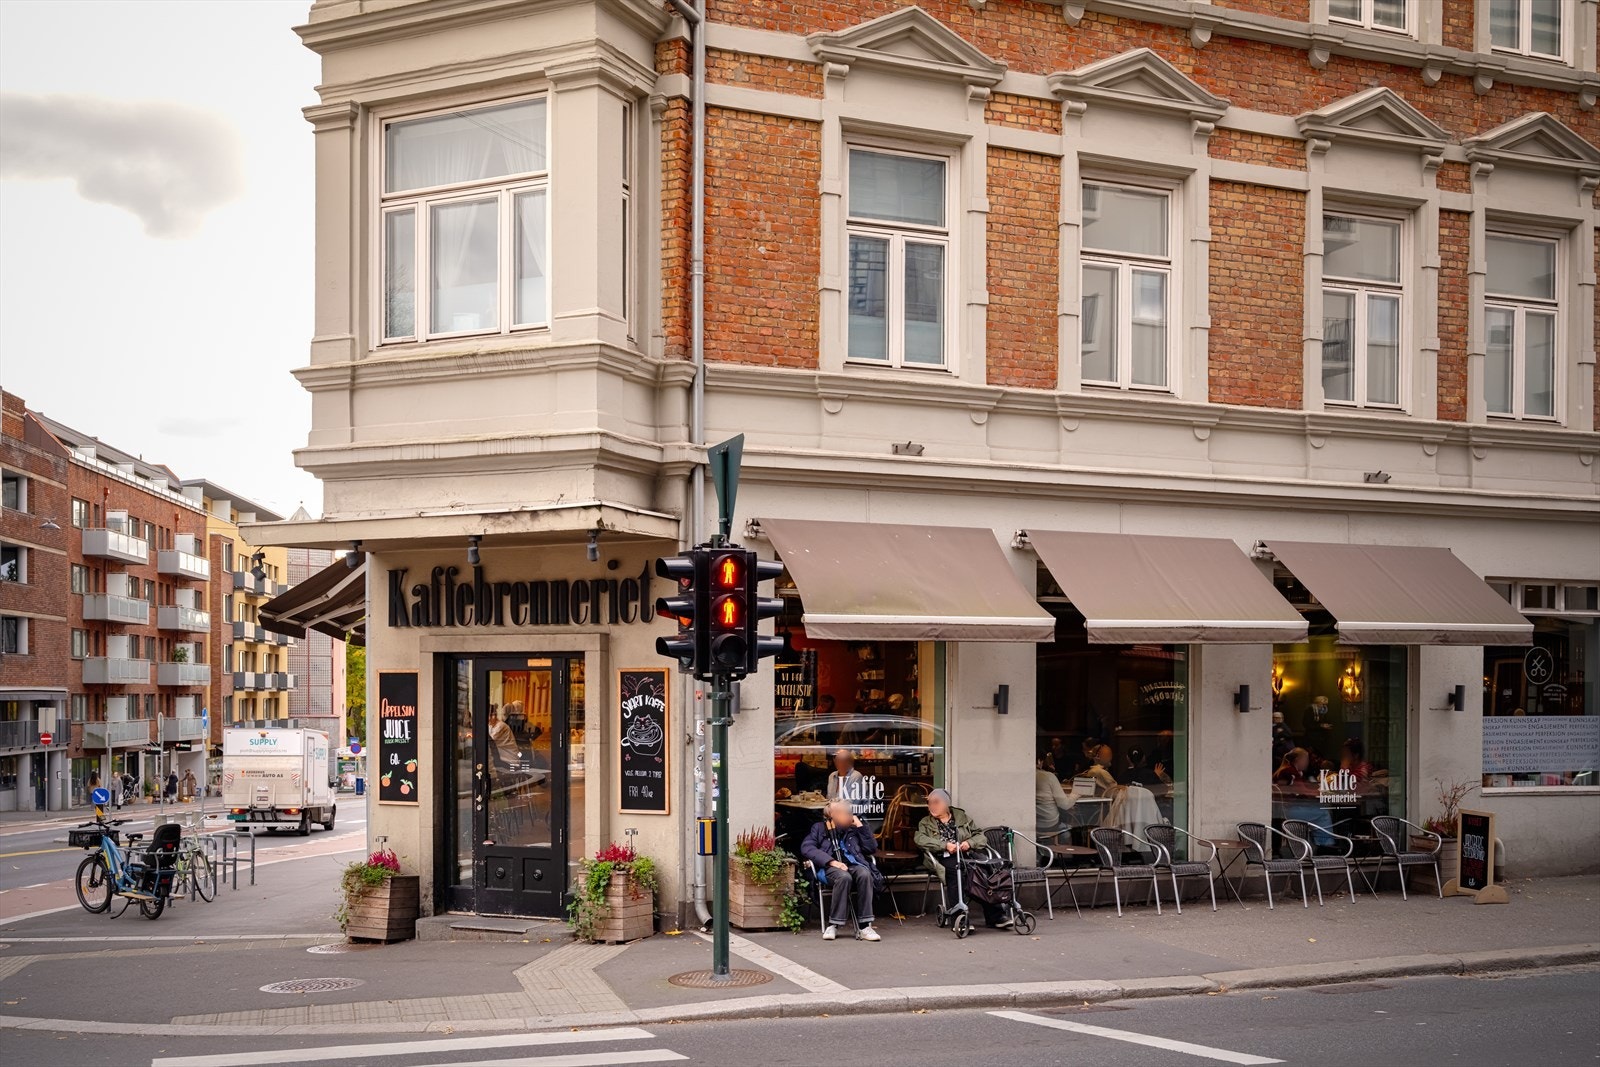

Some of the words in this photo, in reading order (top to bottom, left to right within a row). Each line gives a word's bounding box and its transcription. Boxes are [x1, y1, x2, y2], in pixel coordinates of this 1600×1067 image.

[387, 559, 655, 627] Kaffebrenneriet
[645, 695, 666, 712] KAFFE
[384, 719, 411, 740] JUICE
[838, 775, 885, 800] Kaffe
[1320, 769, 1357, 791] Kaffe
[1320, 792, 1357, 803] brenneriet
